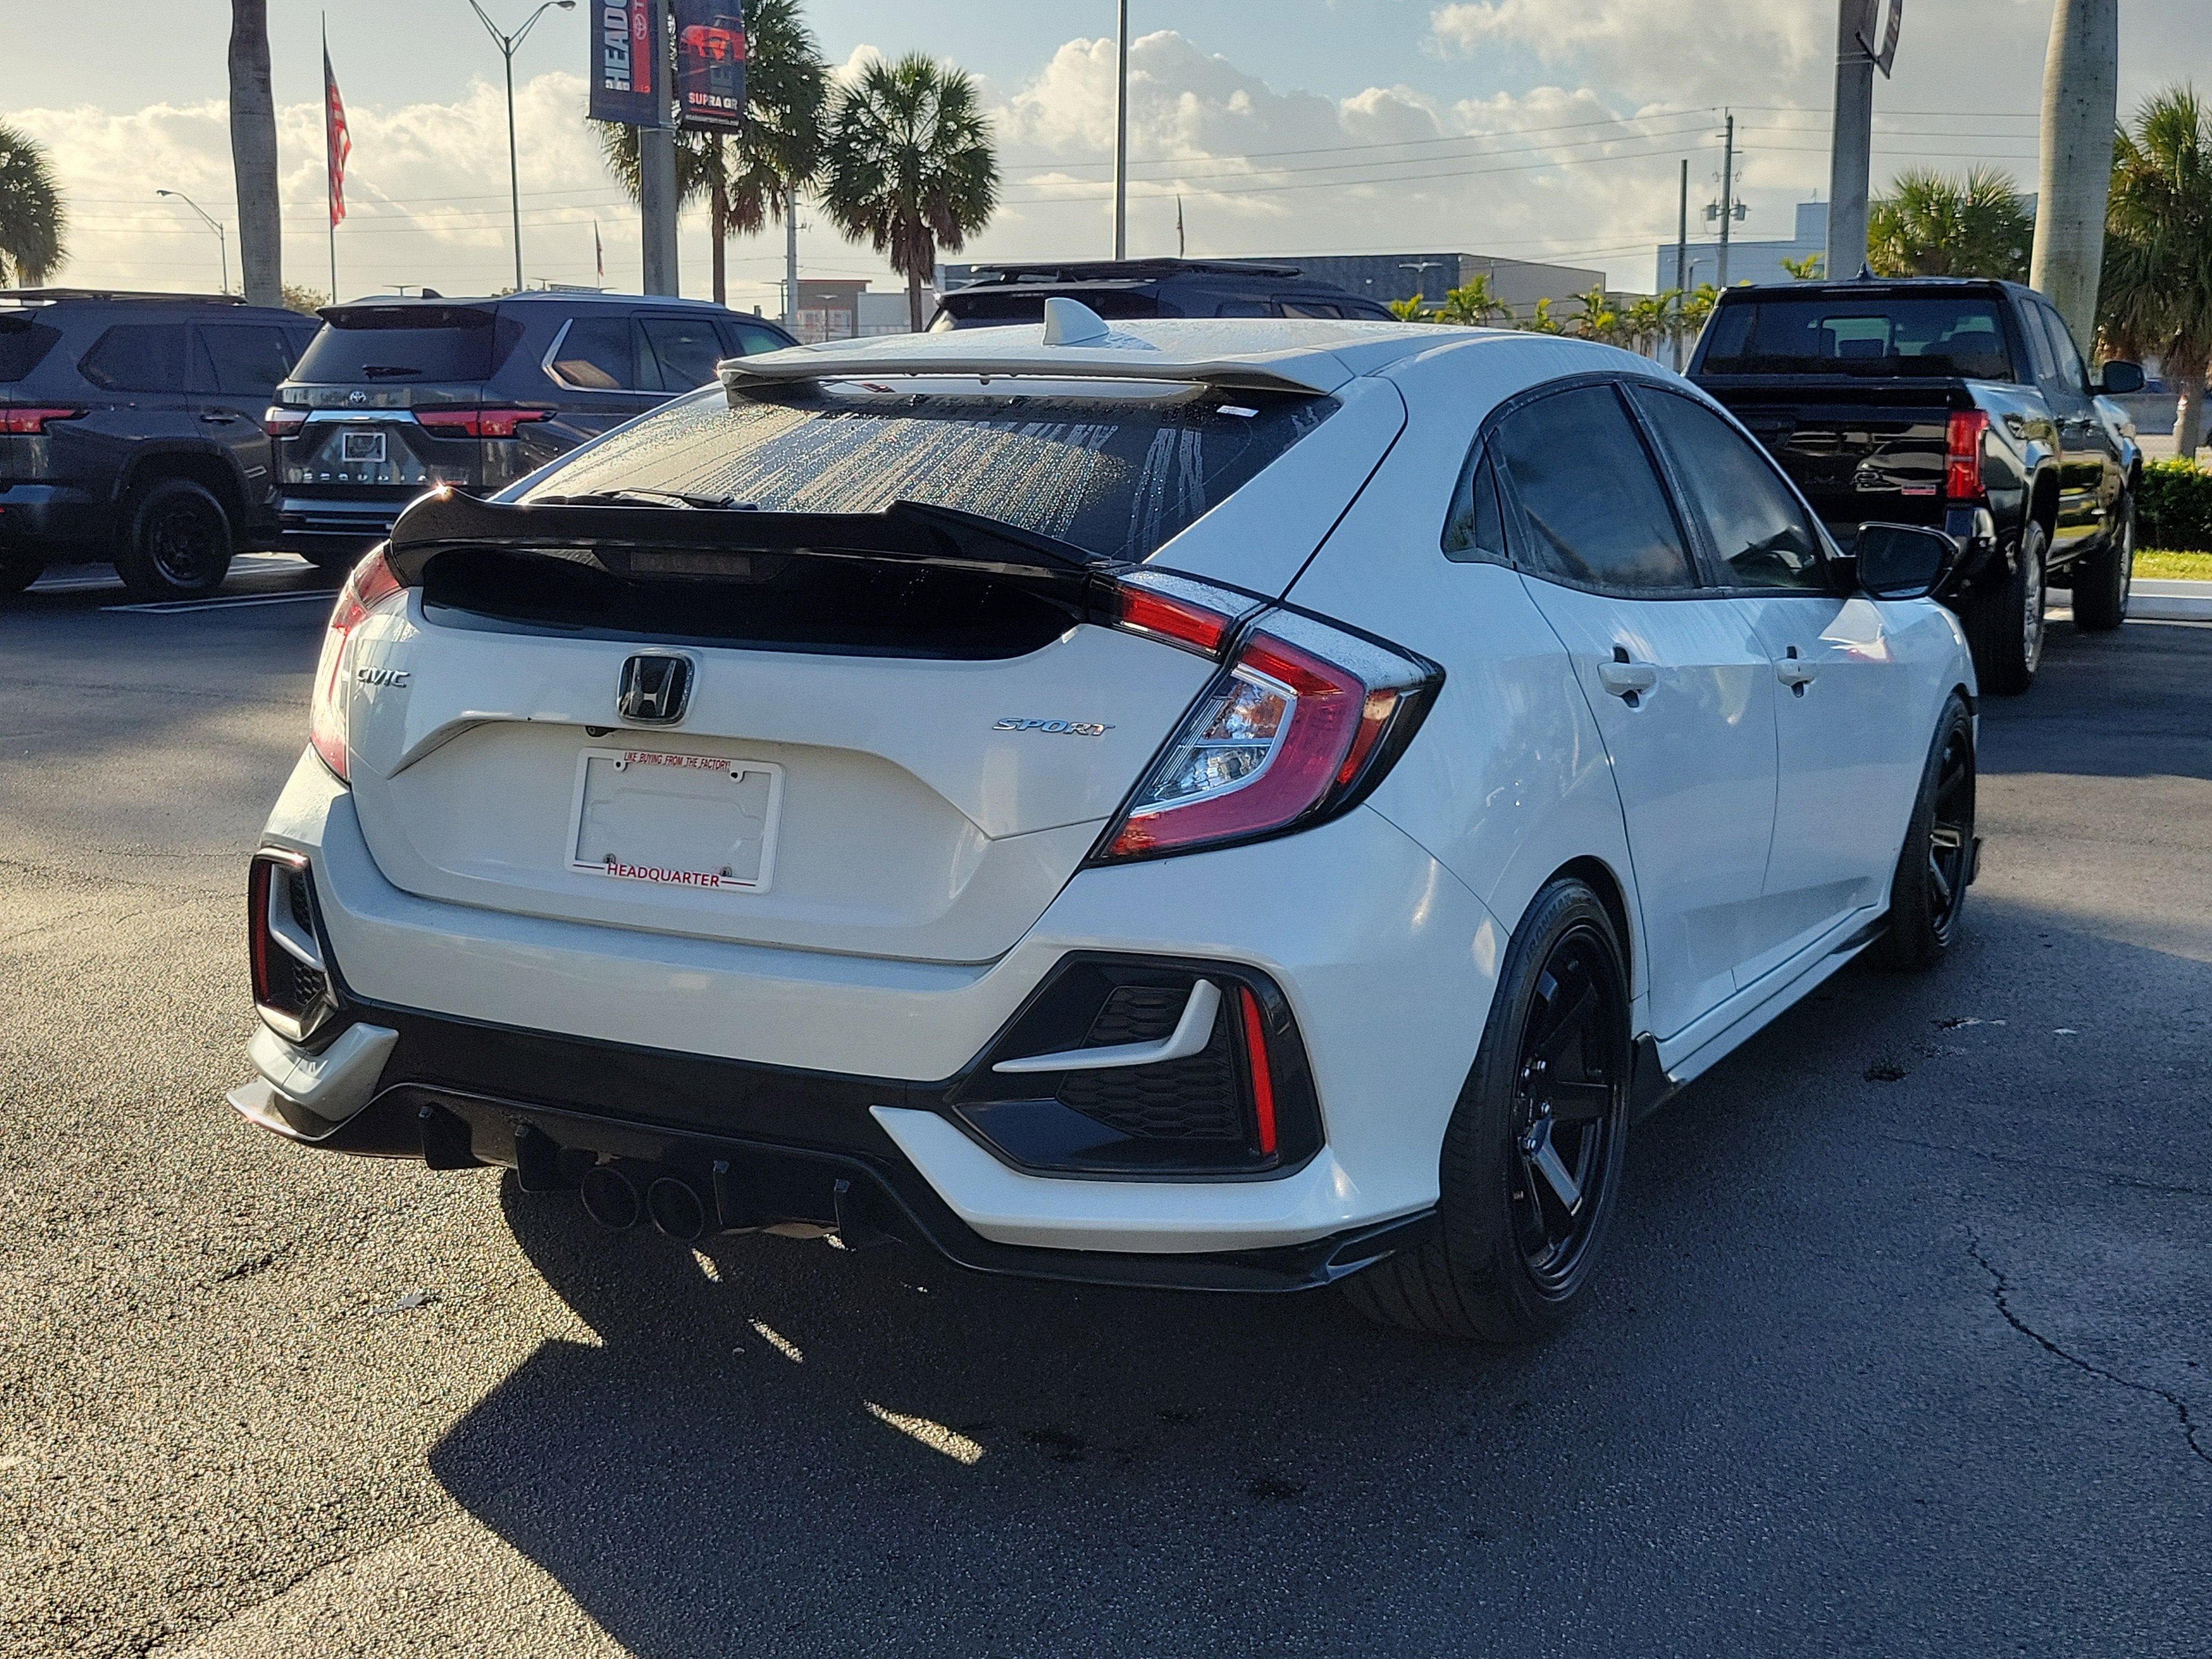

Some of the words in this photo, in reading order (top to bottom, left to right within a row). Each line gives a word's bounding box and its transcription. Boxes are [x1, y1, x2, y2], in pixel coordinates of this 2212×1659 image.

[604, 0, 630, 91] HEAD
[689, 91, 722, 108] SUPRA
[357, 666, 410, 688] CIVIC
[992, 717, 1116, 736] SPORT
[623, 752, 637, 761] LIKE
[639, 753, 662, 764] BUYING
[663, 755, 684, 765] FROM
[684, 757, 698, 767] THE
[607, 863, 720, 887] HEADQUARTER
